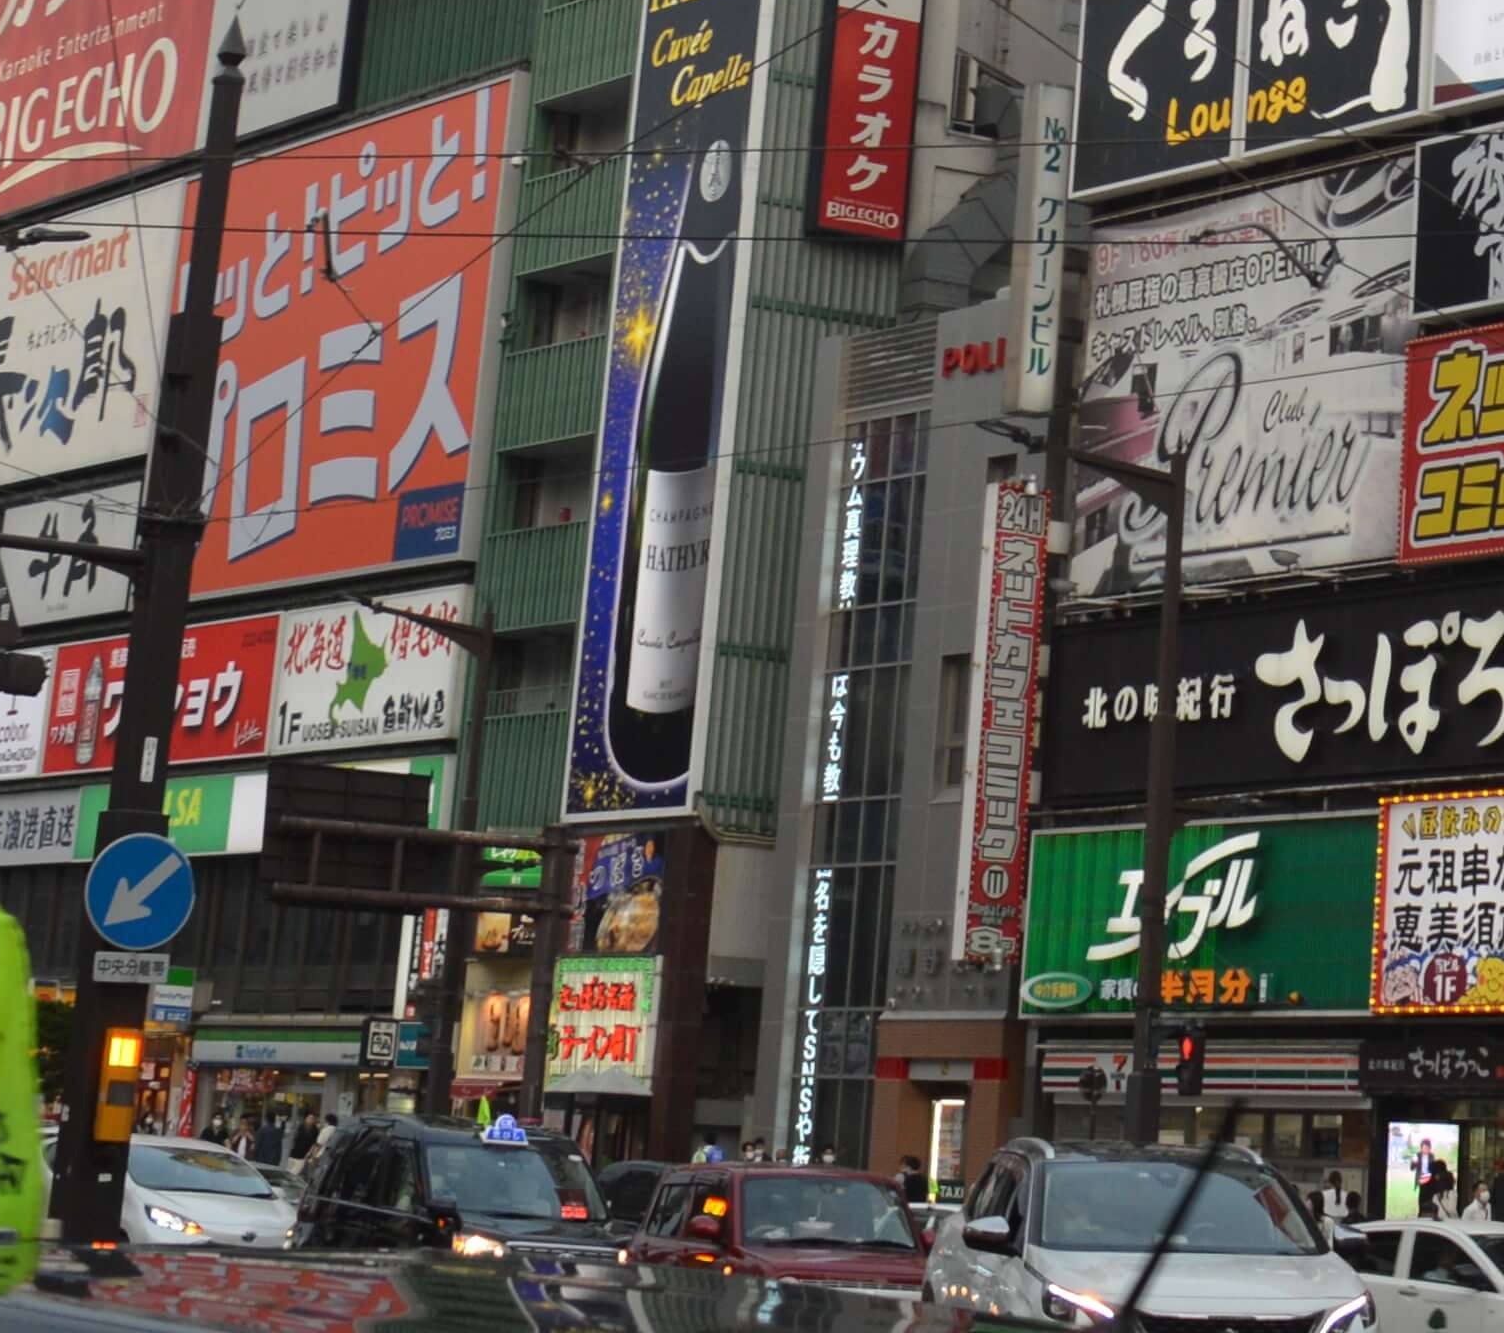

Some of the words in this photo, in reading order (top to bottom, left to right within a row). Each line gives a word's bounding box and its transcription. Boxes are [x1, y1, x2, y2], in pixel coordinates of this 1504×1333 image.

[56, 1, 165, 58] Entertainment
[652, 20, 714, 69] Cuvée
[52, 36, 176, 132] ECHO
[846, 21, 898, 192] カラオケ
[1168, 76, 1307, 145] Lounge
[826, 200, 858, 225] BIG
[858, 203, 901, 230] ECHO
[1026, 195, 1064, 376] グリーンビル
[401, 496, 459, 529] PROMISE
[1002, 491, 1044, 535] 24H
[284, 615, 347, 676] 北海道
[989, 536, 1038, 730] ネットカフェ
[279, 700, 302, 746] 1F
[978, 731, 1024, 862] コミック
[98, 958, 165, 977] 中央分離帯
[1160, 968, 1252, 1005] 半月分
[1433, 976, 1457, 1003] 1F
[1408, 1047, 1490, 1080] さっぽろっこ
[940, 1183, 964, 1199] TAXI
